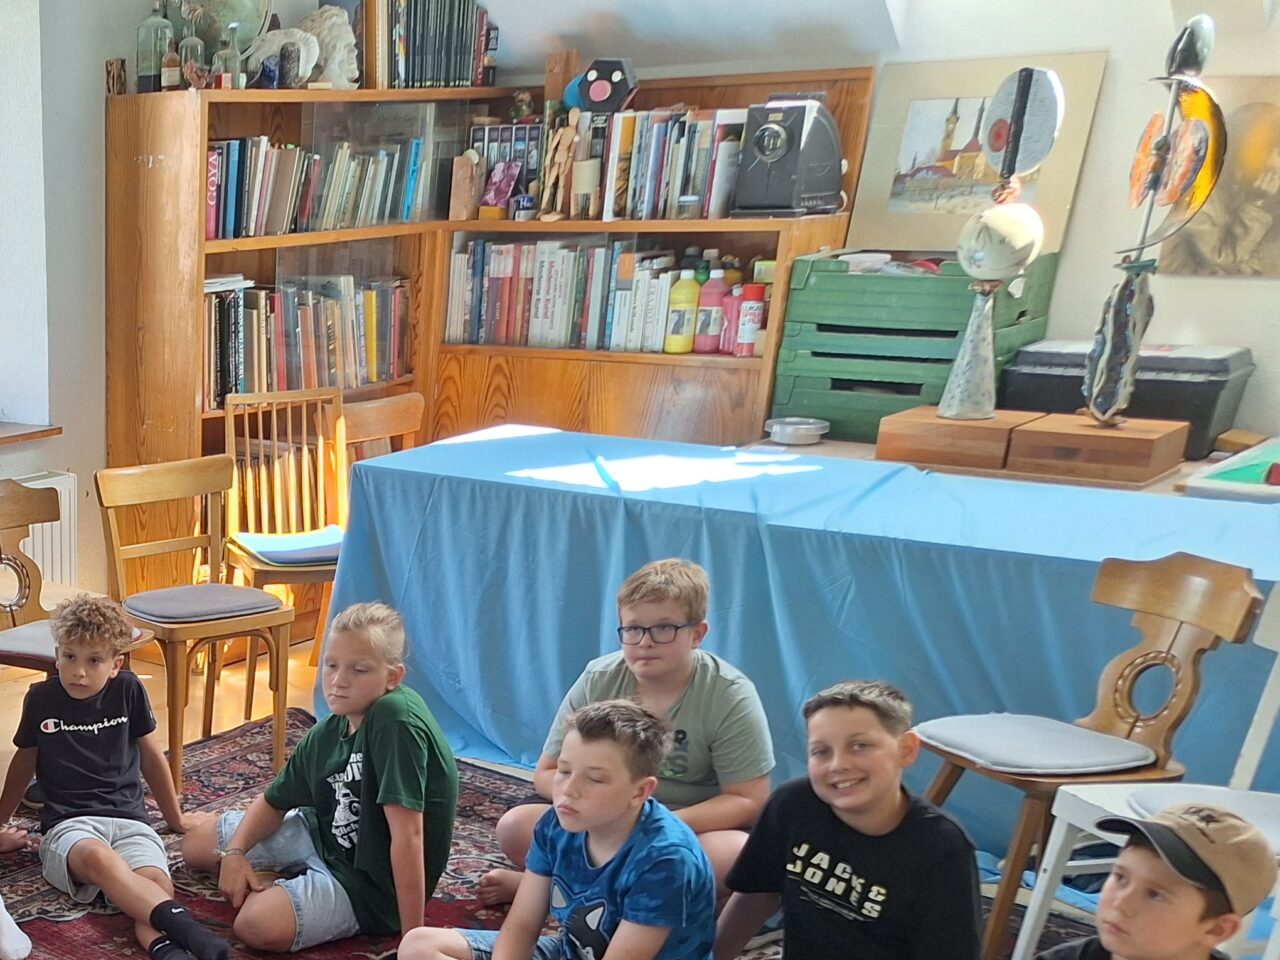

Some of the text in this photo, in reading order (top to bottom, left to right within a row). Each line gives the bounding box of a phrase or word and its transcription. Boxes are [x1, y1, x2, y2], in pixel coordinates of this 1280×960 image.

[207, 154, 218, 206] GOYA
[40, 717, 128, 735] Champion
[785, 859, 882, 918] JONES
